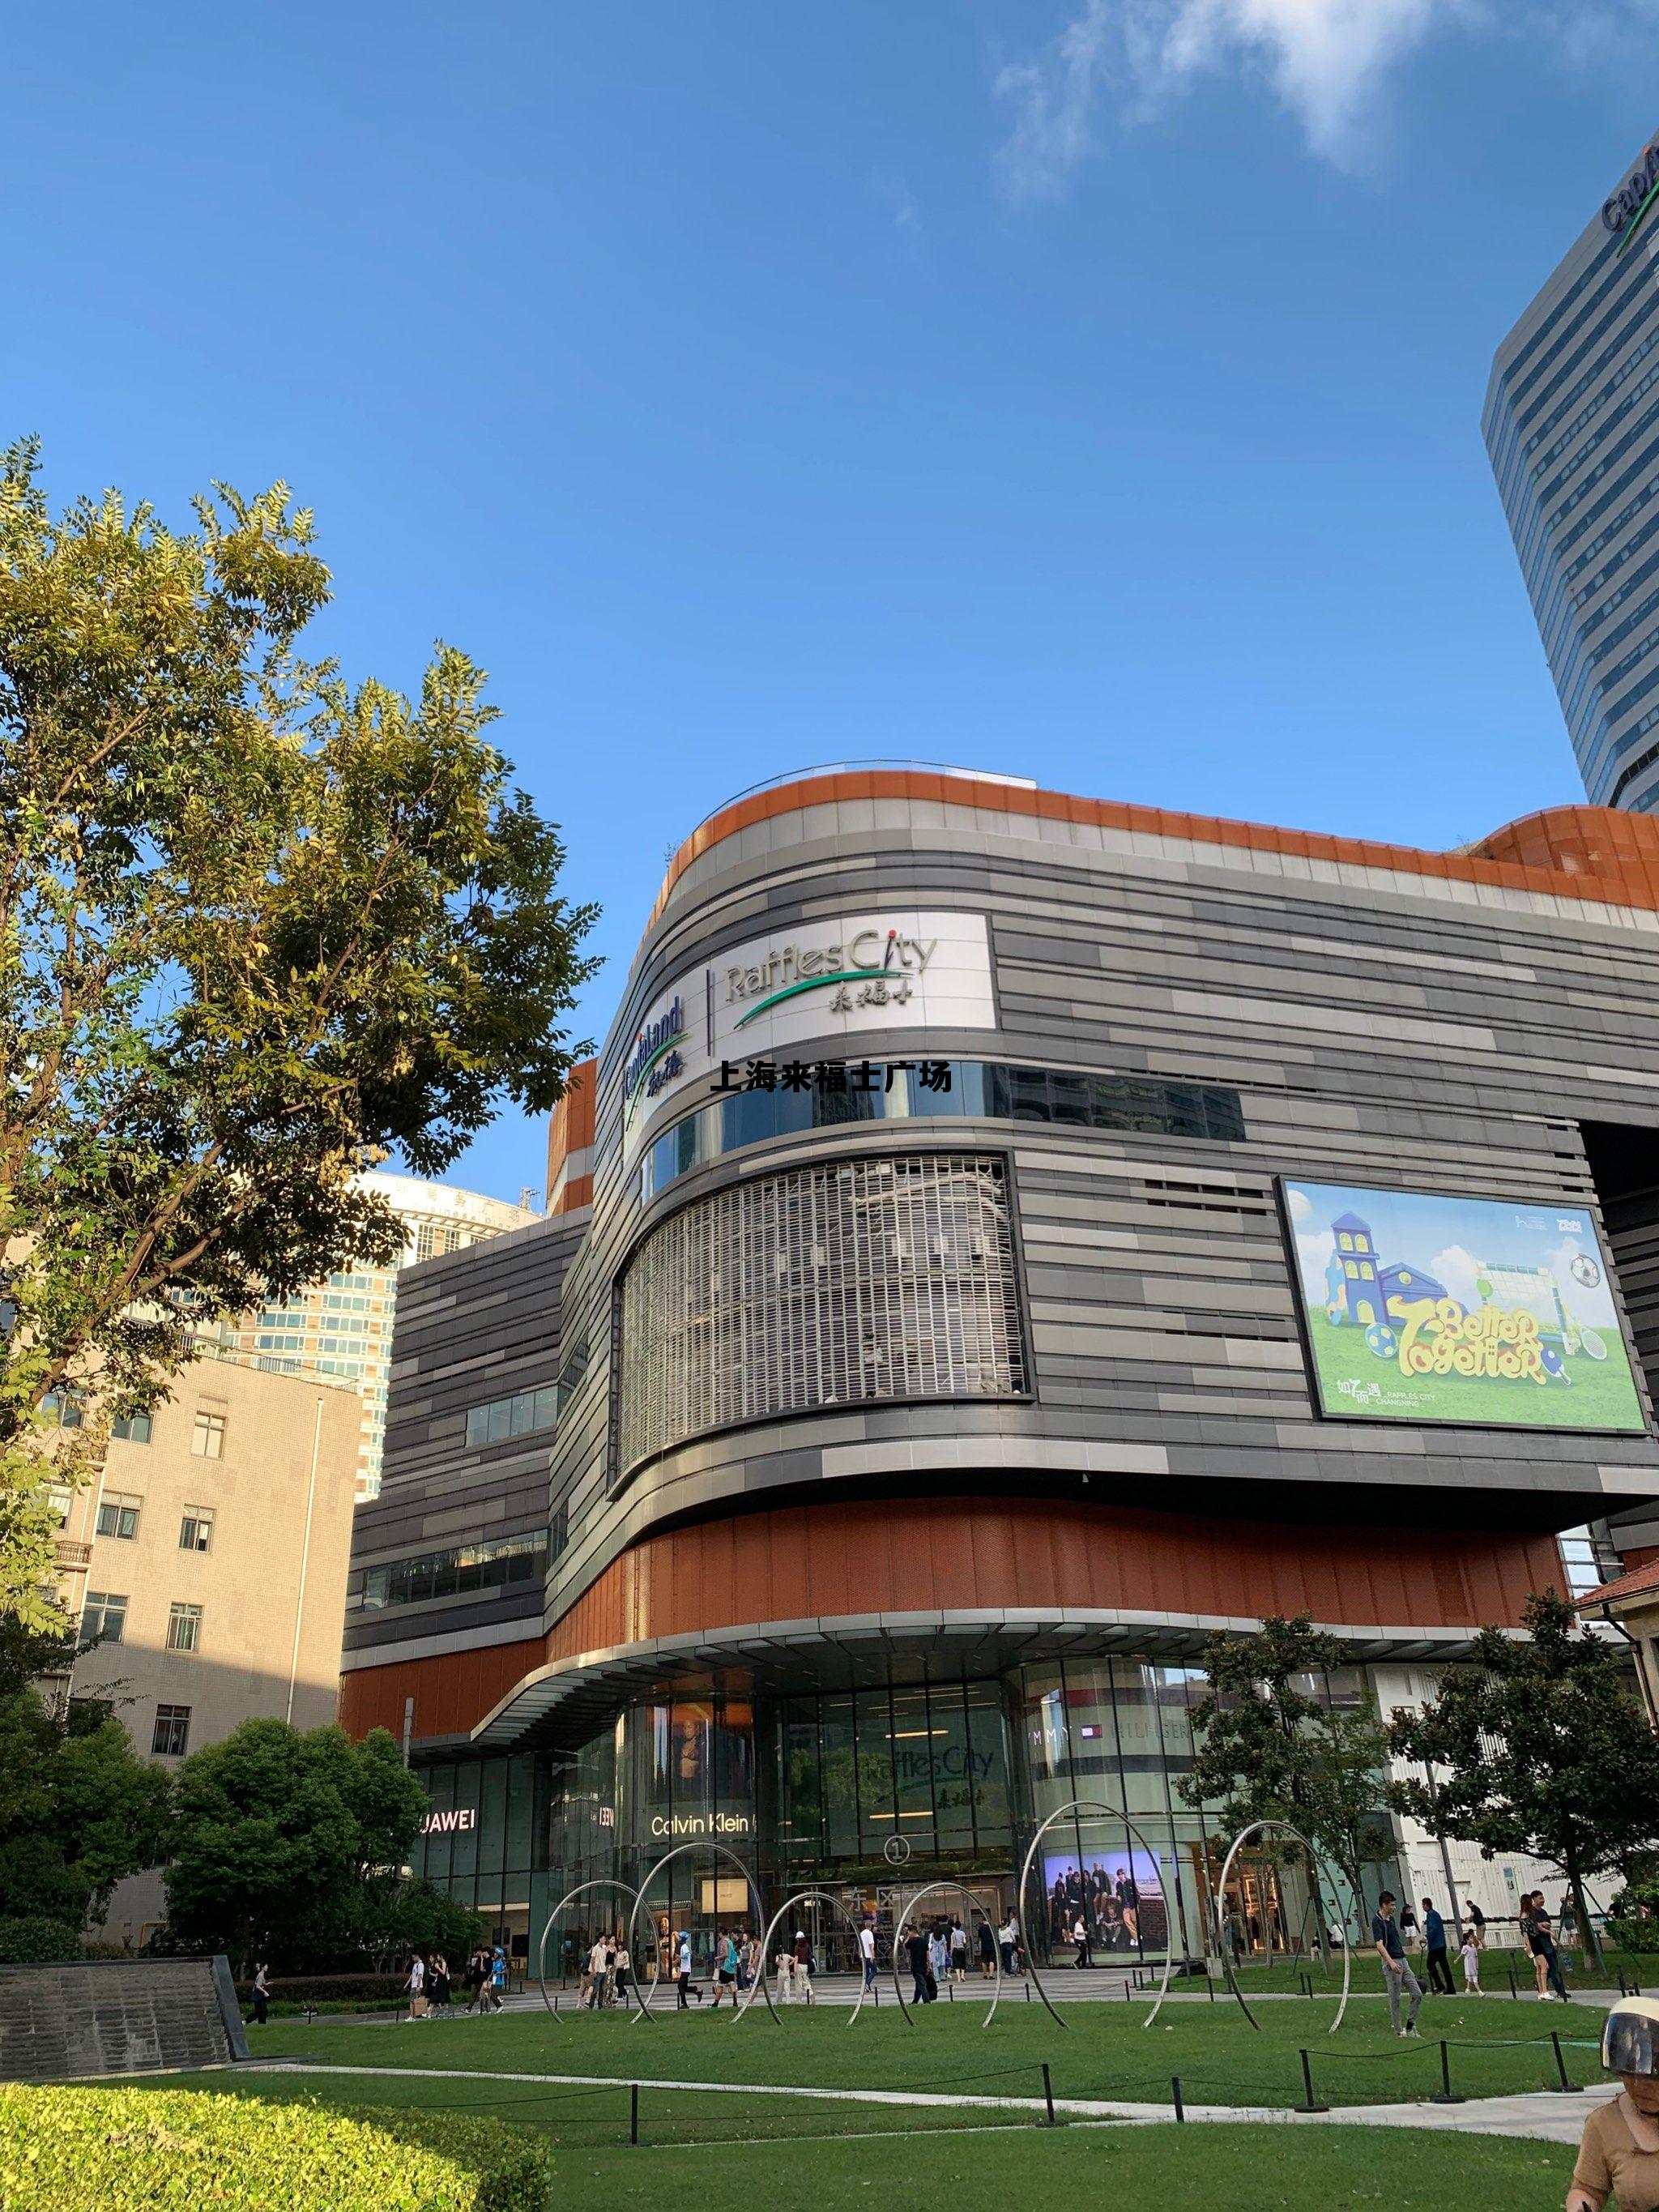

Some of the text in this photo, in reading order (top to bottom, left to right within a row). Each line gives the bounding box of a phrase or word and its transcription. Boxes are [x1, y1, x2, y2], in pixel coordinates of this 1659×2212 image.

[1601, 143, 1659, 232] Capi
[829, 980, 914, 1012] 来福士
[710, 1059, 953, 1093] 上海来福士广场
[651, 1813, 748, 1836] Calvin Klein
